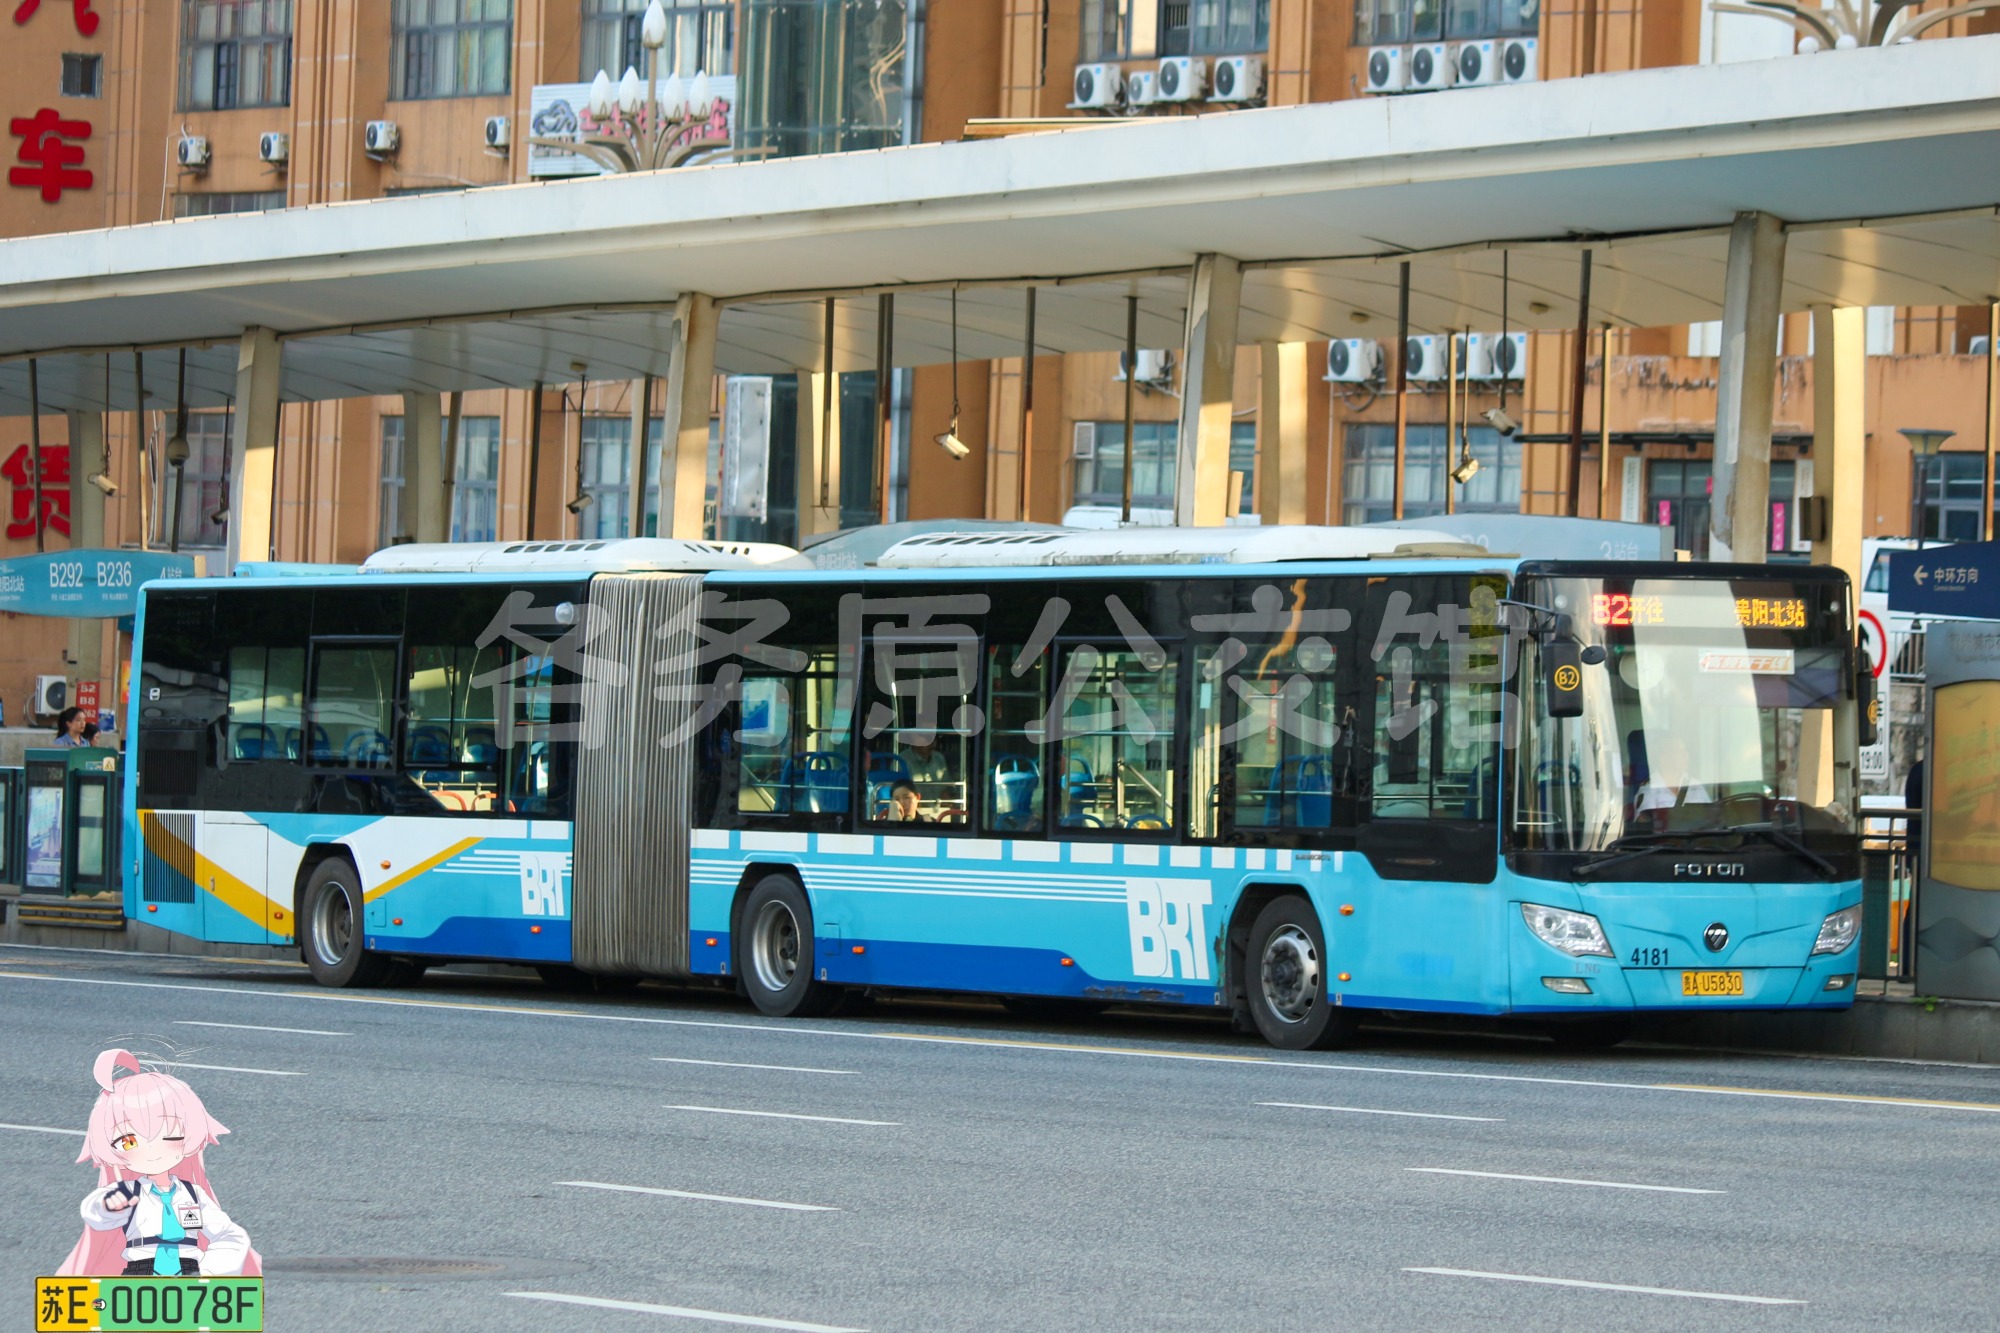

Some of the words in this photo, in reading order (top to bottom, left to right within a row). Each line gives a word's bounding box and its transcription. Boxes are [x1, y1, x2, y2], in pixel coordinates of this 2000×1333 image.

[9, 108, 93, 202] 车
[50, 563, 83, 587] B292
[97, 562, 132, 587] B236
[1934, 567, 1979, 584] 中环方向
[1734, 599, 1806, 627] 贵阳北站
[1559, 671, 1576, 685] B2
[1674, 863, 1745, 876] FOTON
[520, 850, 566, 916] BRT
[1125, 879, 1213, 979] BRT
[1631, 948, 1669, 966] 4181
[1576, 963, 1601, 975] LNG
